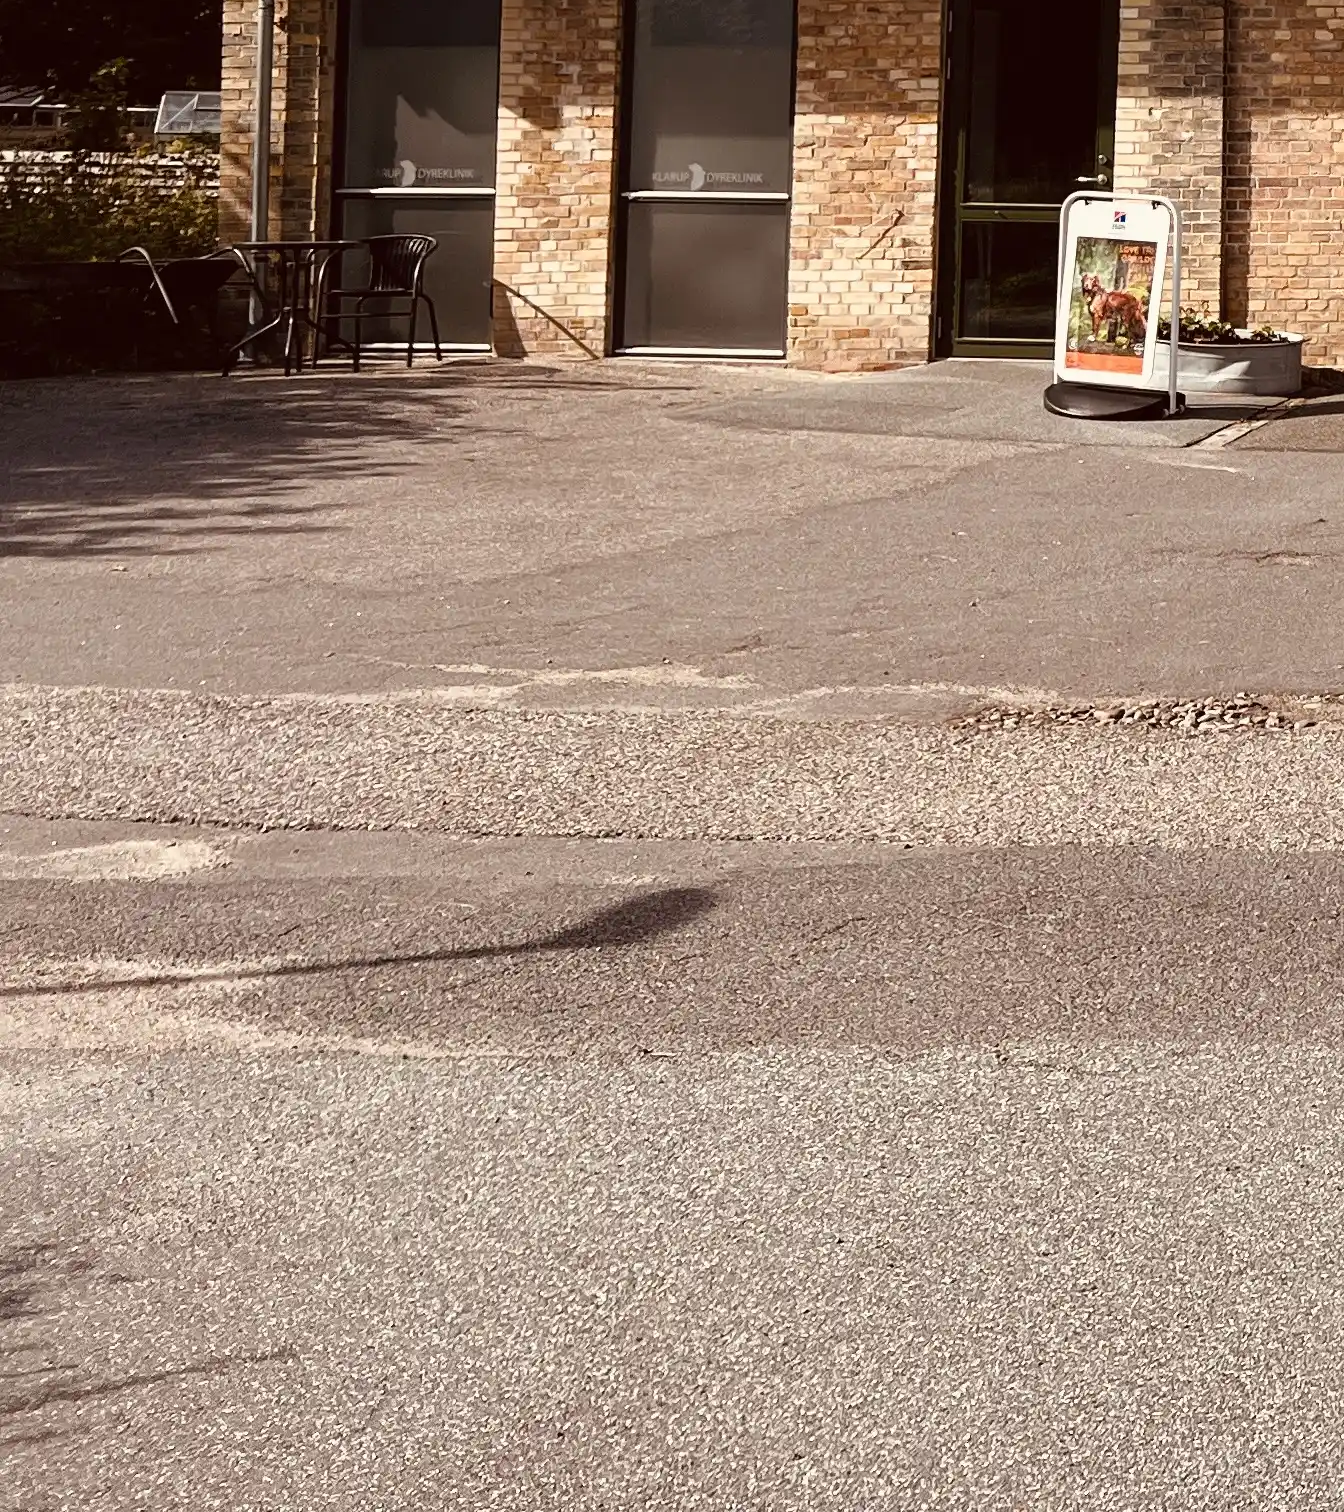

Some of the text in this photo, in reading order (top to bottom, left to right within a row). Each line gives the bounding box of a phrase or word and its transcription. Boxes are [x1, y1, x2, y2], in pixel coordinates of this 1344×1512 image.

[417, 168, 475, 180] DYREKLINIK
[652, 172, 764, 184] KLARUP DYREKLINIK
